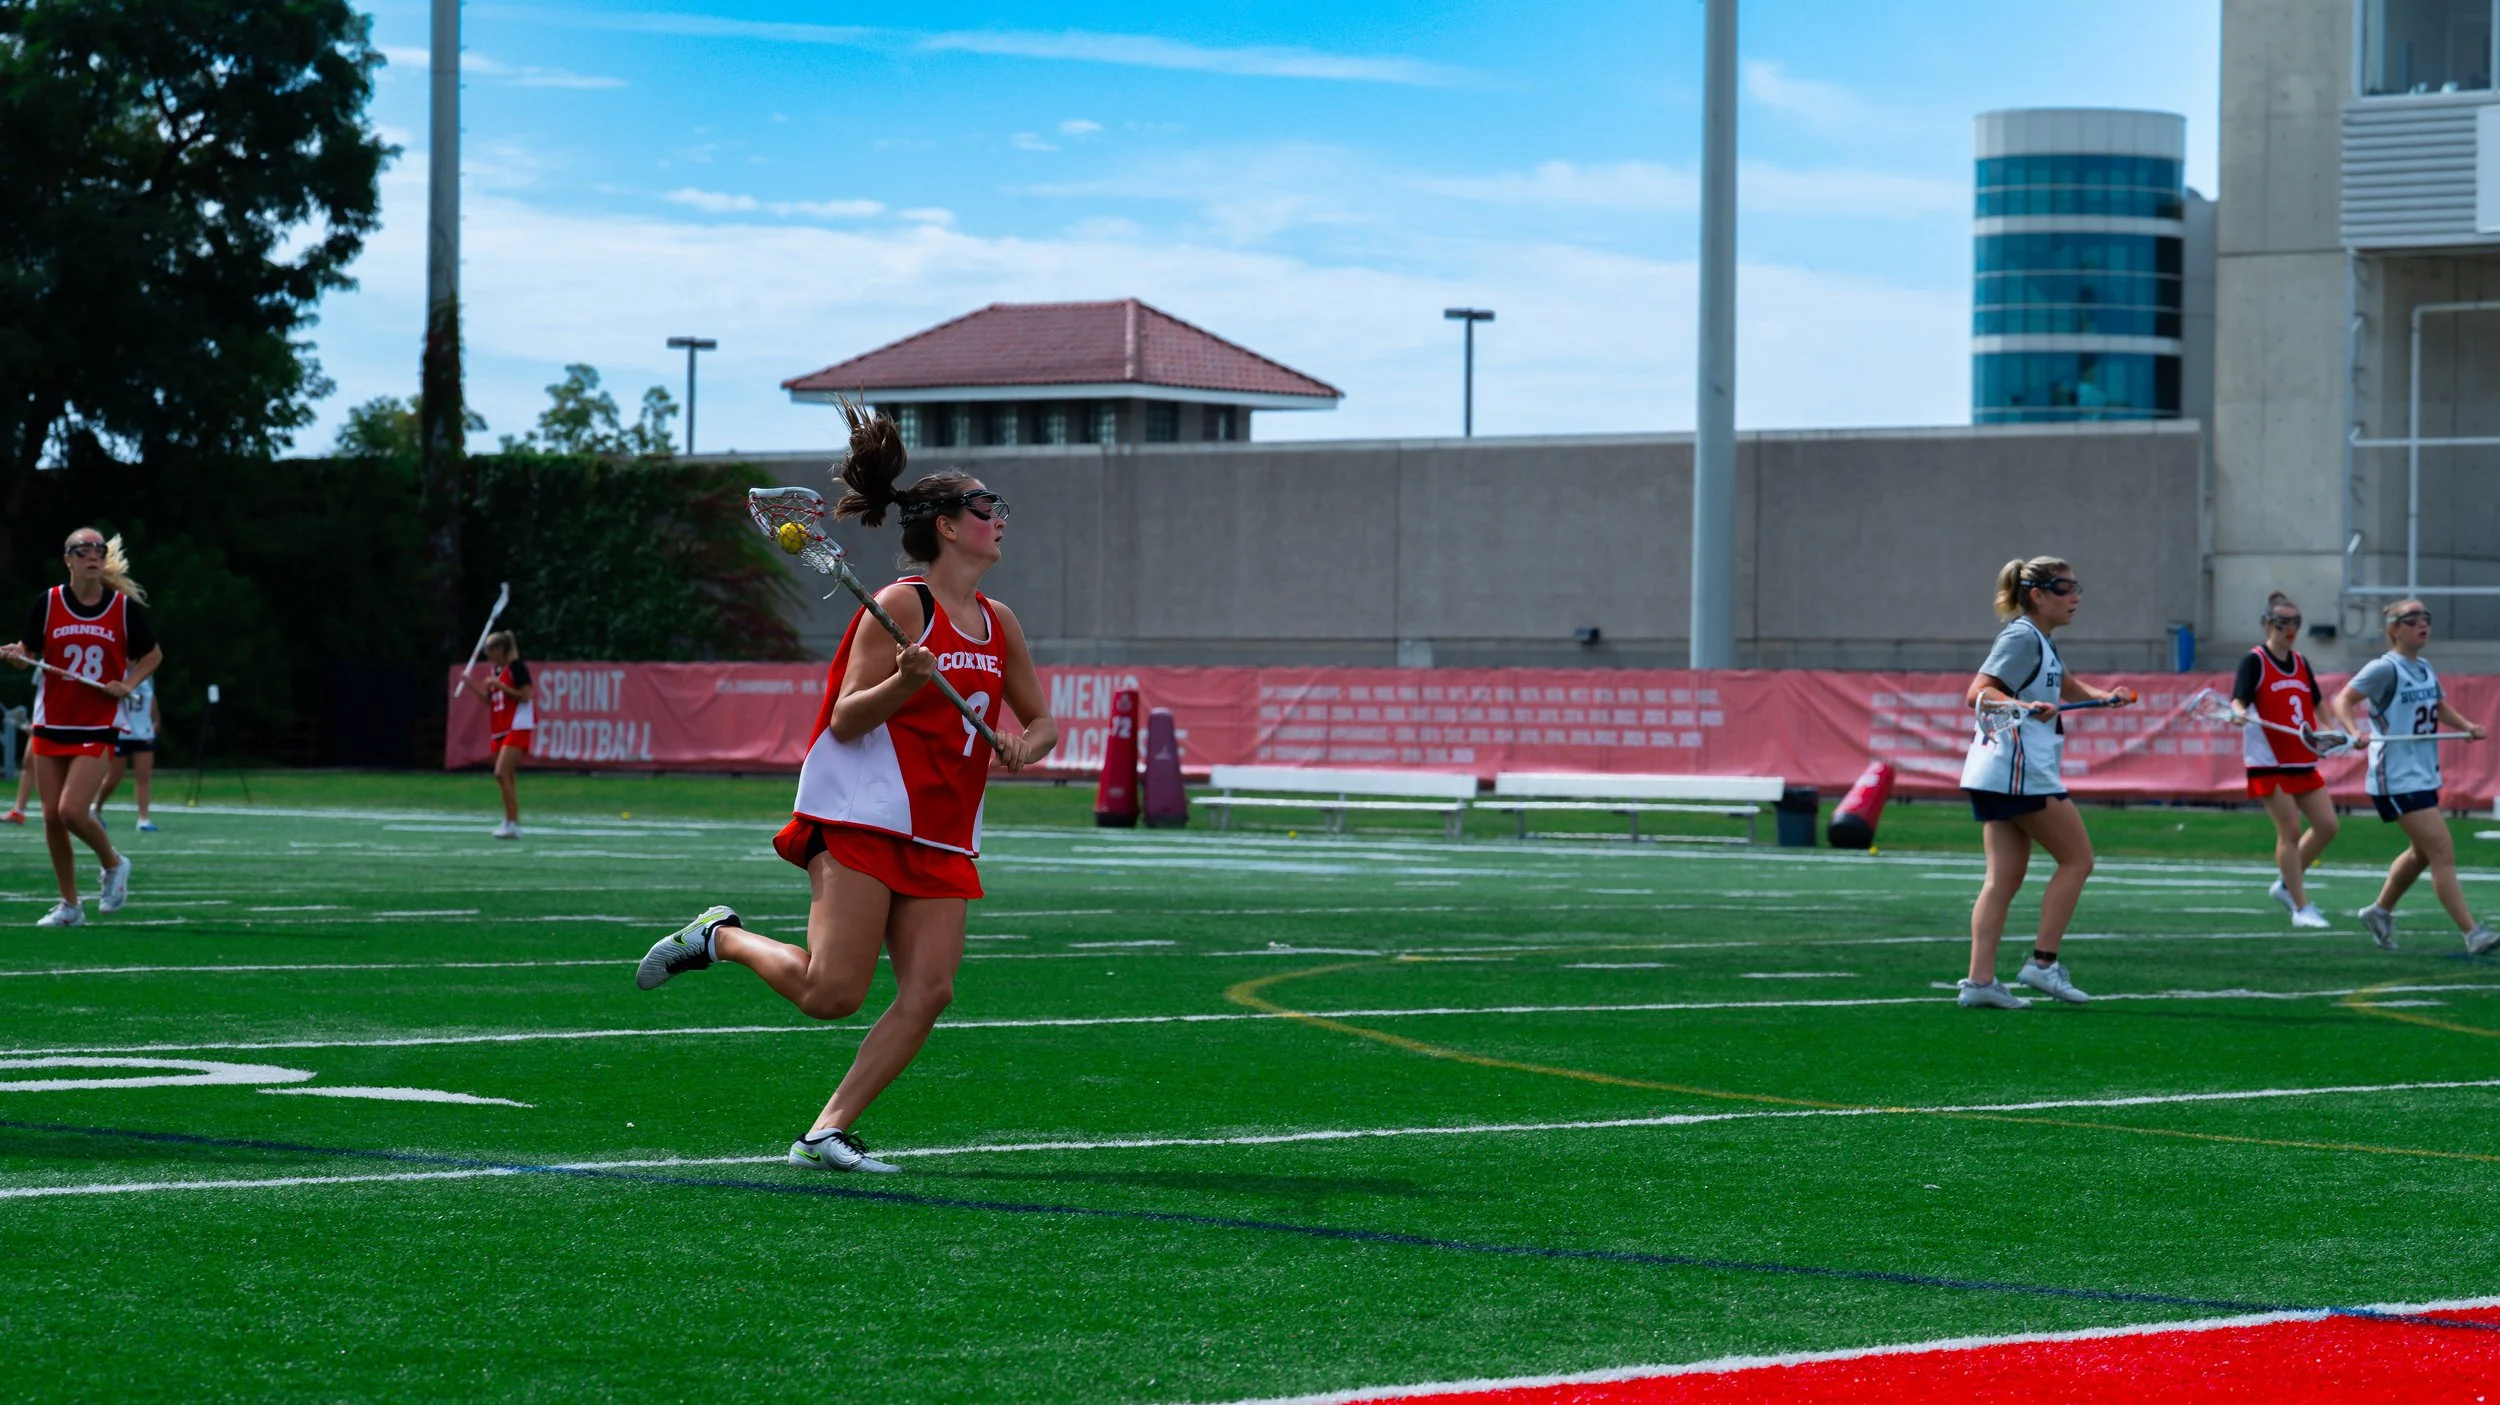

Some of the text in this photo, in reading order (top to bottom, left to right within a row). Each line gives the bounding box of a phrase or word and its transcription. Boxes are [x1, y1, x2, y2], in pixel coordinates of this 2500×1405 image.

[53, 624, 116, 642] CORNELL
[63, 644, 104, 682] 28
[937, 651, 1003, 678] CORNE
[537, 669, 625, 713] SPRINT
[2288, 695, 2304, 726] 3
[533, 718, 654, 762] FOOTBALL
